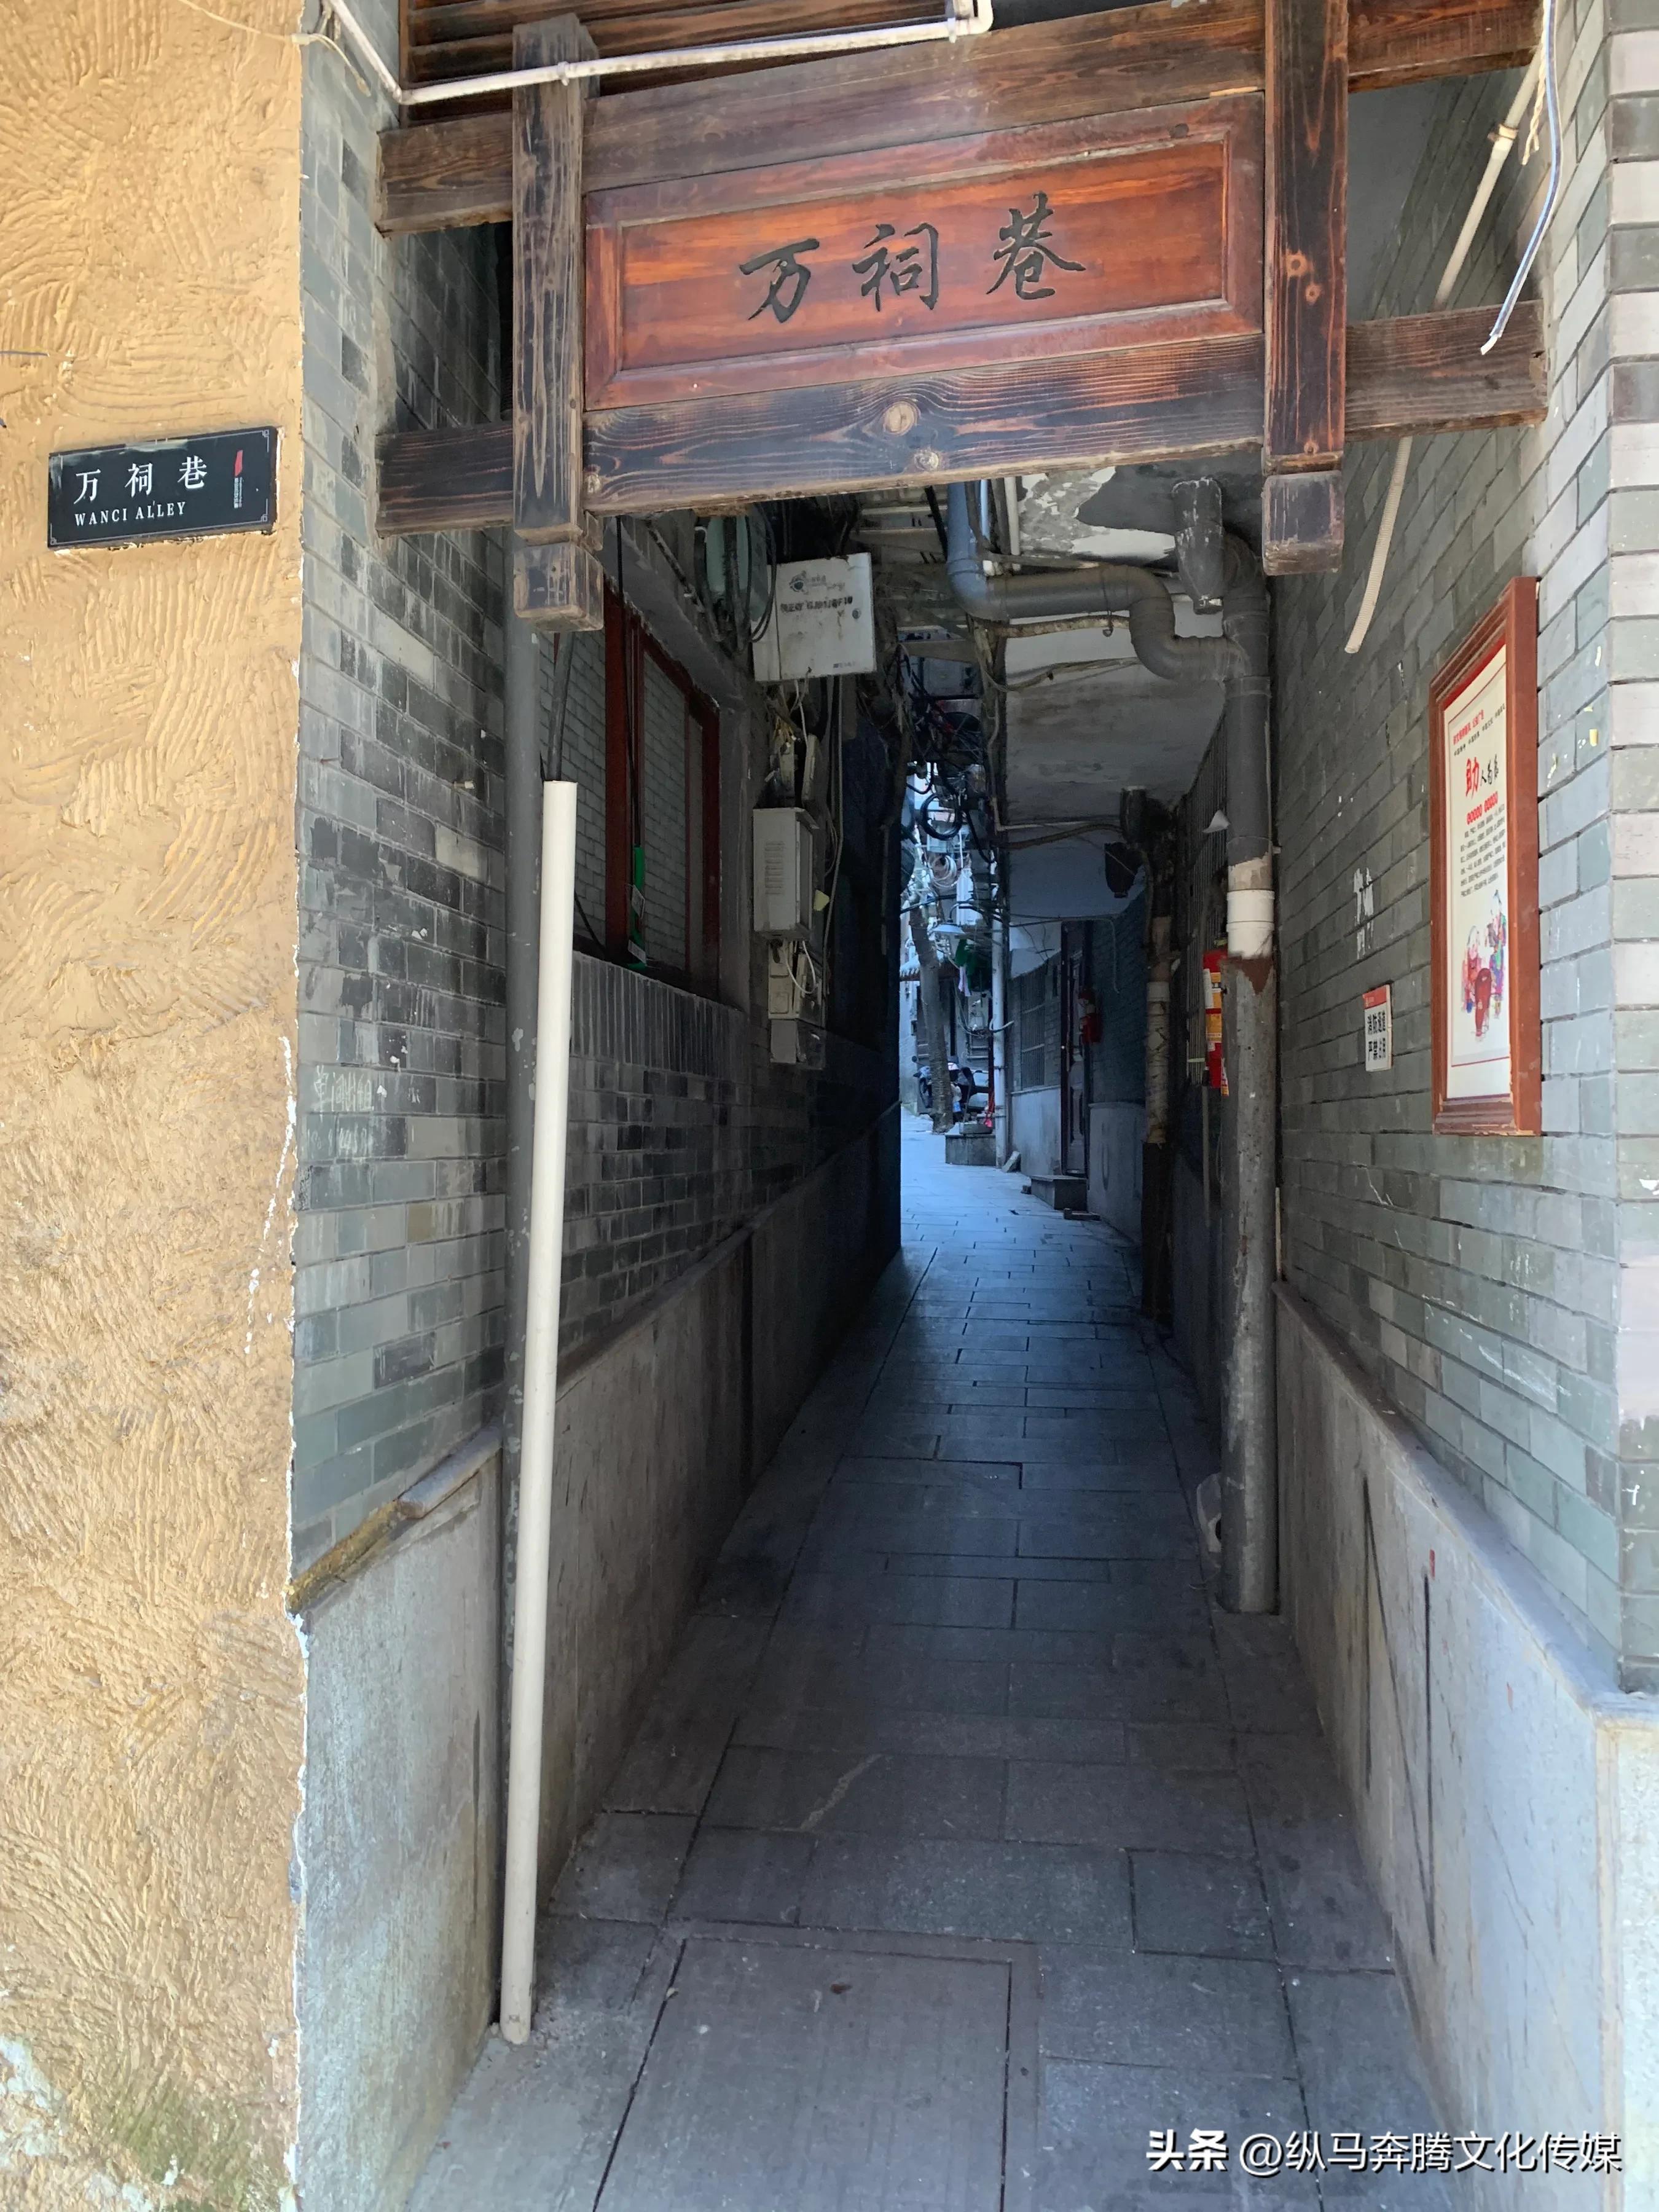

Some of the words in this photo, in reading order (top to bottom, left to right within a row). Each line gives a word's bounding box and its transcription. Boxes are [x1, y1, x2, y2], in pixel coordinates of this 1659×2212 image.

[739, 191, 1086, 323] 万祠巷
[73, 456, 207, 504] 万祠巷
[75, 509, 127, 526] WANCI
[135, 501, 186, 520] ALLEY
